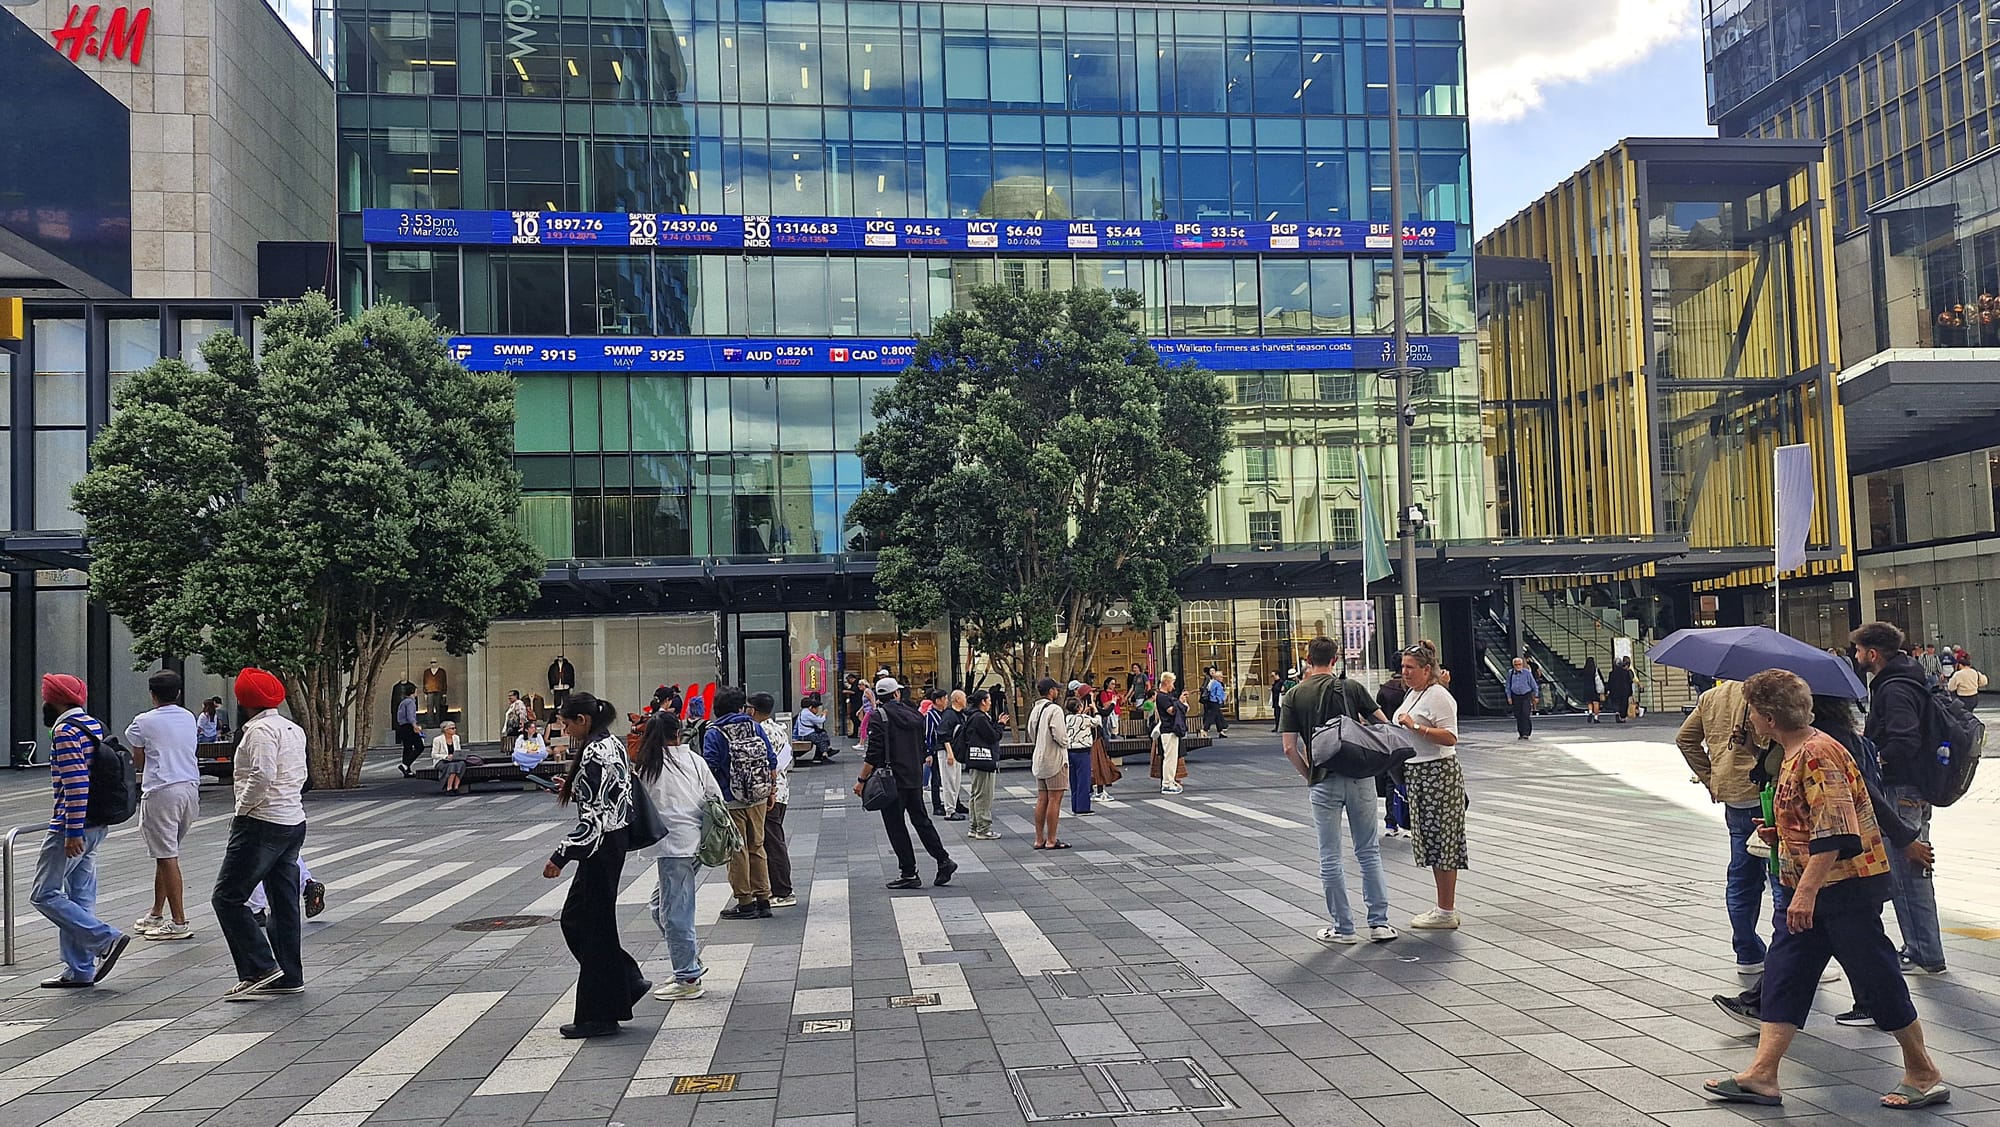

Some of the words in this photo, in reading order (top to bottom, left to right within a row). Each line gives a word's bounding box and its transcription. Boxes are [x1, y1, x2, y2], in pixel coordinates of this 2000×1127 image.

[51, 4, 151, 65] H&M
[400, 213, 455, 230] 3:53pm
[514, 218, 538, 236] 10
[546, 219, 603, 231] 1897.76
[662, 221, 717, 232] 7439.06
[866, 221, 895, 232] KPG
[398, 227, 408, 236] 17
[412, 227, 432, 236] Mar
[435, 227, 459, 237] 2026
[630, 221, 657, 238] 20
[744, 222, 770, 240] 50
[775, 223, 838, 234] 13146.83
[905, 225, 941, 236] 94.5¢
[967, 222, 998, 233] MCY
[1006, 226, 1042, 237] $6.40
[1069, 223, 1097, 234] MEL
[1106, 226, 1142, 238] $5.44
[1175, 224, 1201, 234] BFG
[1211, 227, 1245, 238] 33.5¢
[1271, 224, 1298, 234] BGP
[1307, 227, 1342, 238] $4.72
[1370, 224, 1390, 234] BIF
[1402, 227, 1436, 238] $1.49
[512, 236, 541, 244] INDEX
[629, 237, 658, 246] INDEX
[744, 239, 771, 247] INDEX
[493, 345, 534, 356] SWMP
[540, 349, 577, 361] 3915
[1158, 343, 1174, 353] hits
[1176, 343, 1212, 353] Waikato
[1214, 343, 1248, 352] farmers
[1250, 344, 1260, 352] as
[1262, 342, 1294, 352] harvest
[1329, 342, 1352, 351] costs
[1383, 341, 1429, 356] 3:3pm
[604, 345, 644, 356] SWMP
[650, 350, 685, 362] 3925
[746, 350, 773, 361] AUD
[776, 346, 814, 356] 0.8261
[852, 350, 878, 360] CAD
[1381, 353, 1391, 362] 17
[1412, 353, 1432, 361] 2026
[504, 358, 524, 367] APR
[613, 358, 635, 367] MAY
